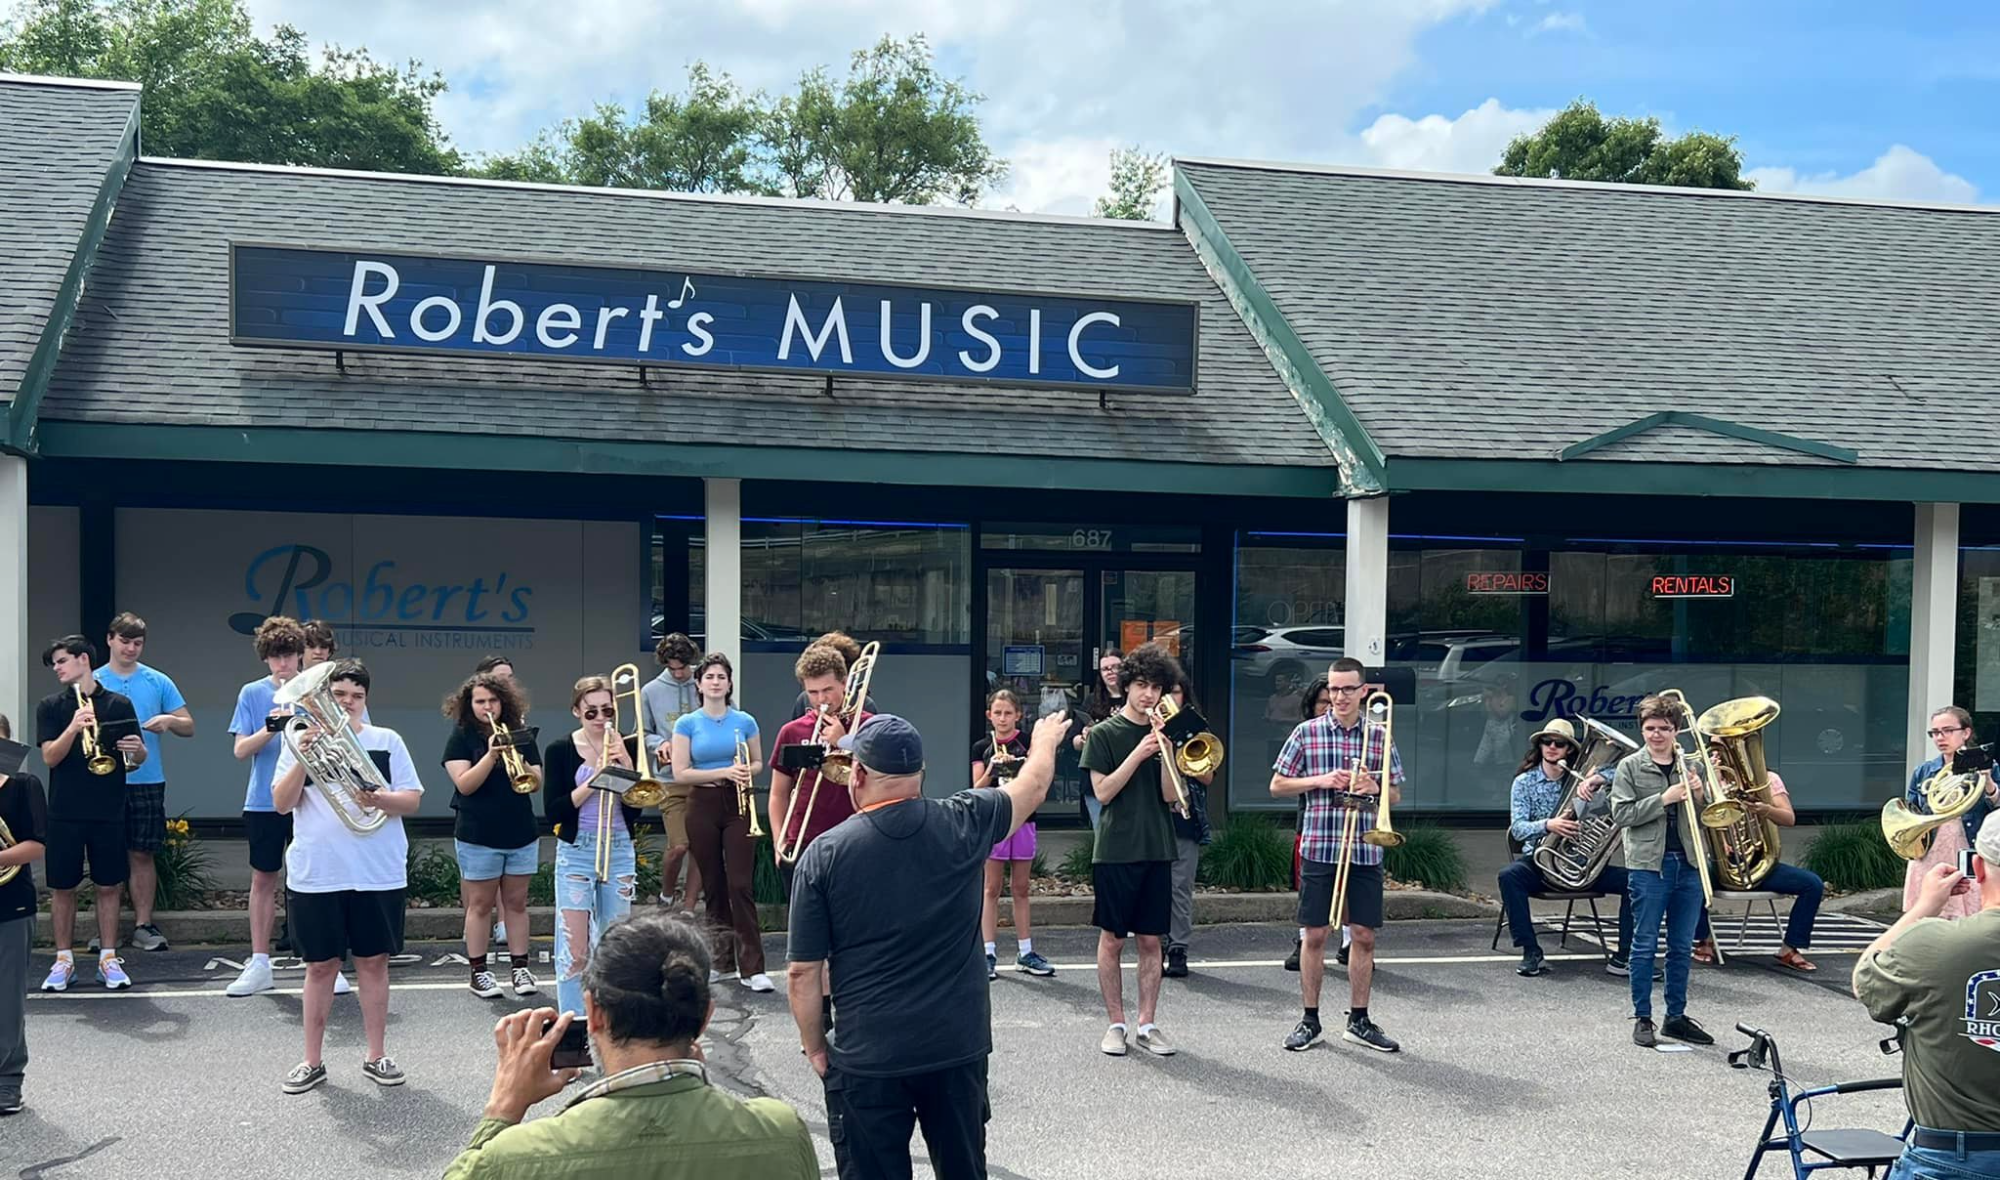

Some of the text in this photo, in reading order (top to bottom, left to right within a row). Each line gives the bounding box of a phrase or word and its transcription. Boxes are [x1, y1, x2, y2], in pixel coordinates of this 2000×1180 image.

[343, 260, 1121, 379] Robert's MUSIC
[1072, 529, 1112, 547] 687
[228, 543, 533, 635] Robert's
[1467, 573, 1547, 591] REPAIRS
[1652, 576, 1730, 594] RENTALS
[414, 633, 534, 650] INSTRUMENTS
